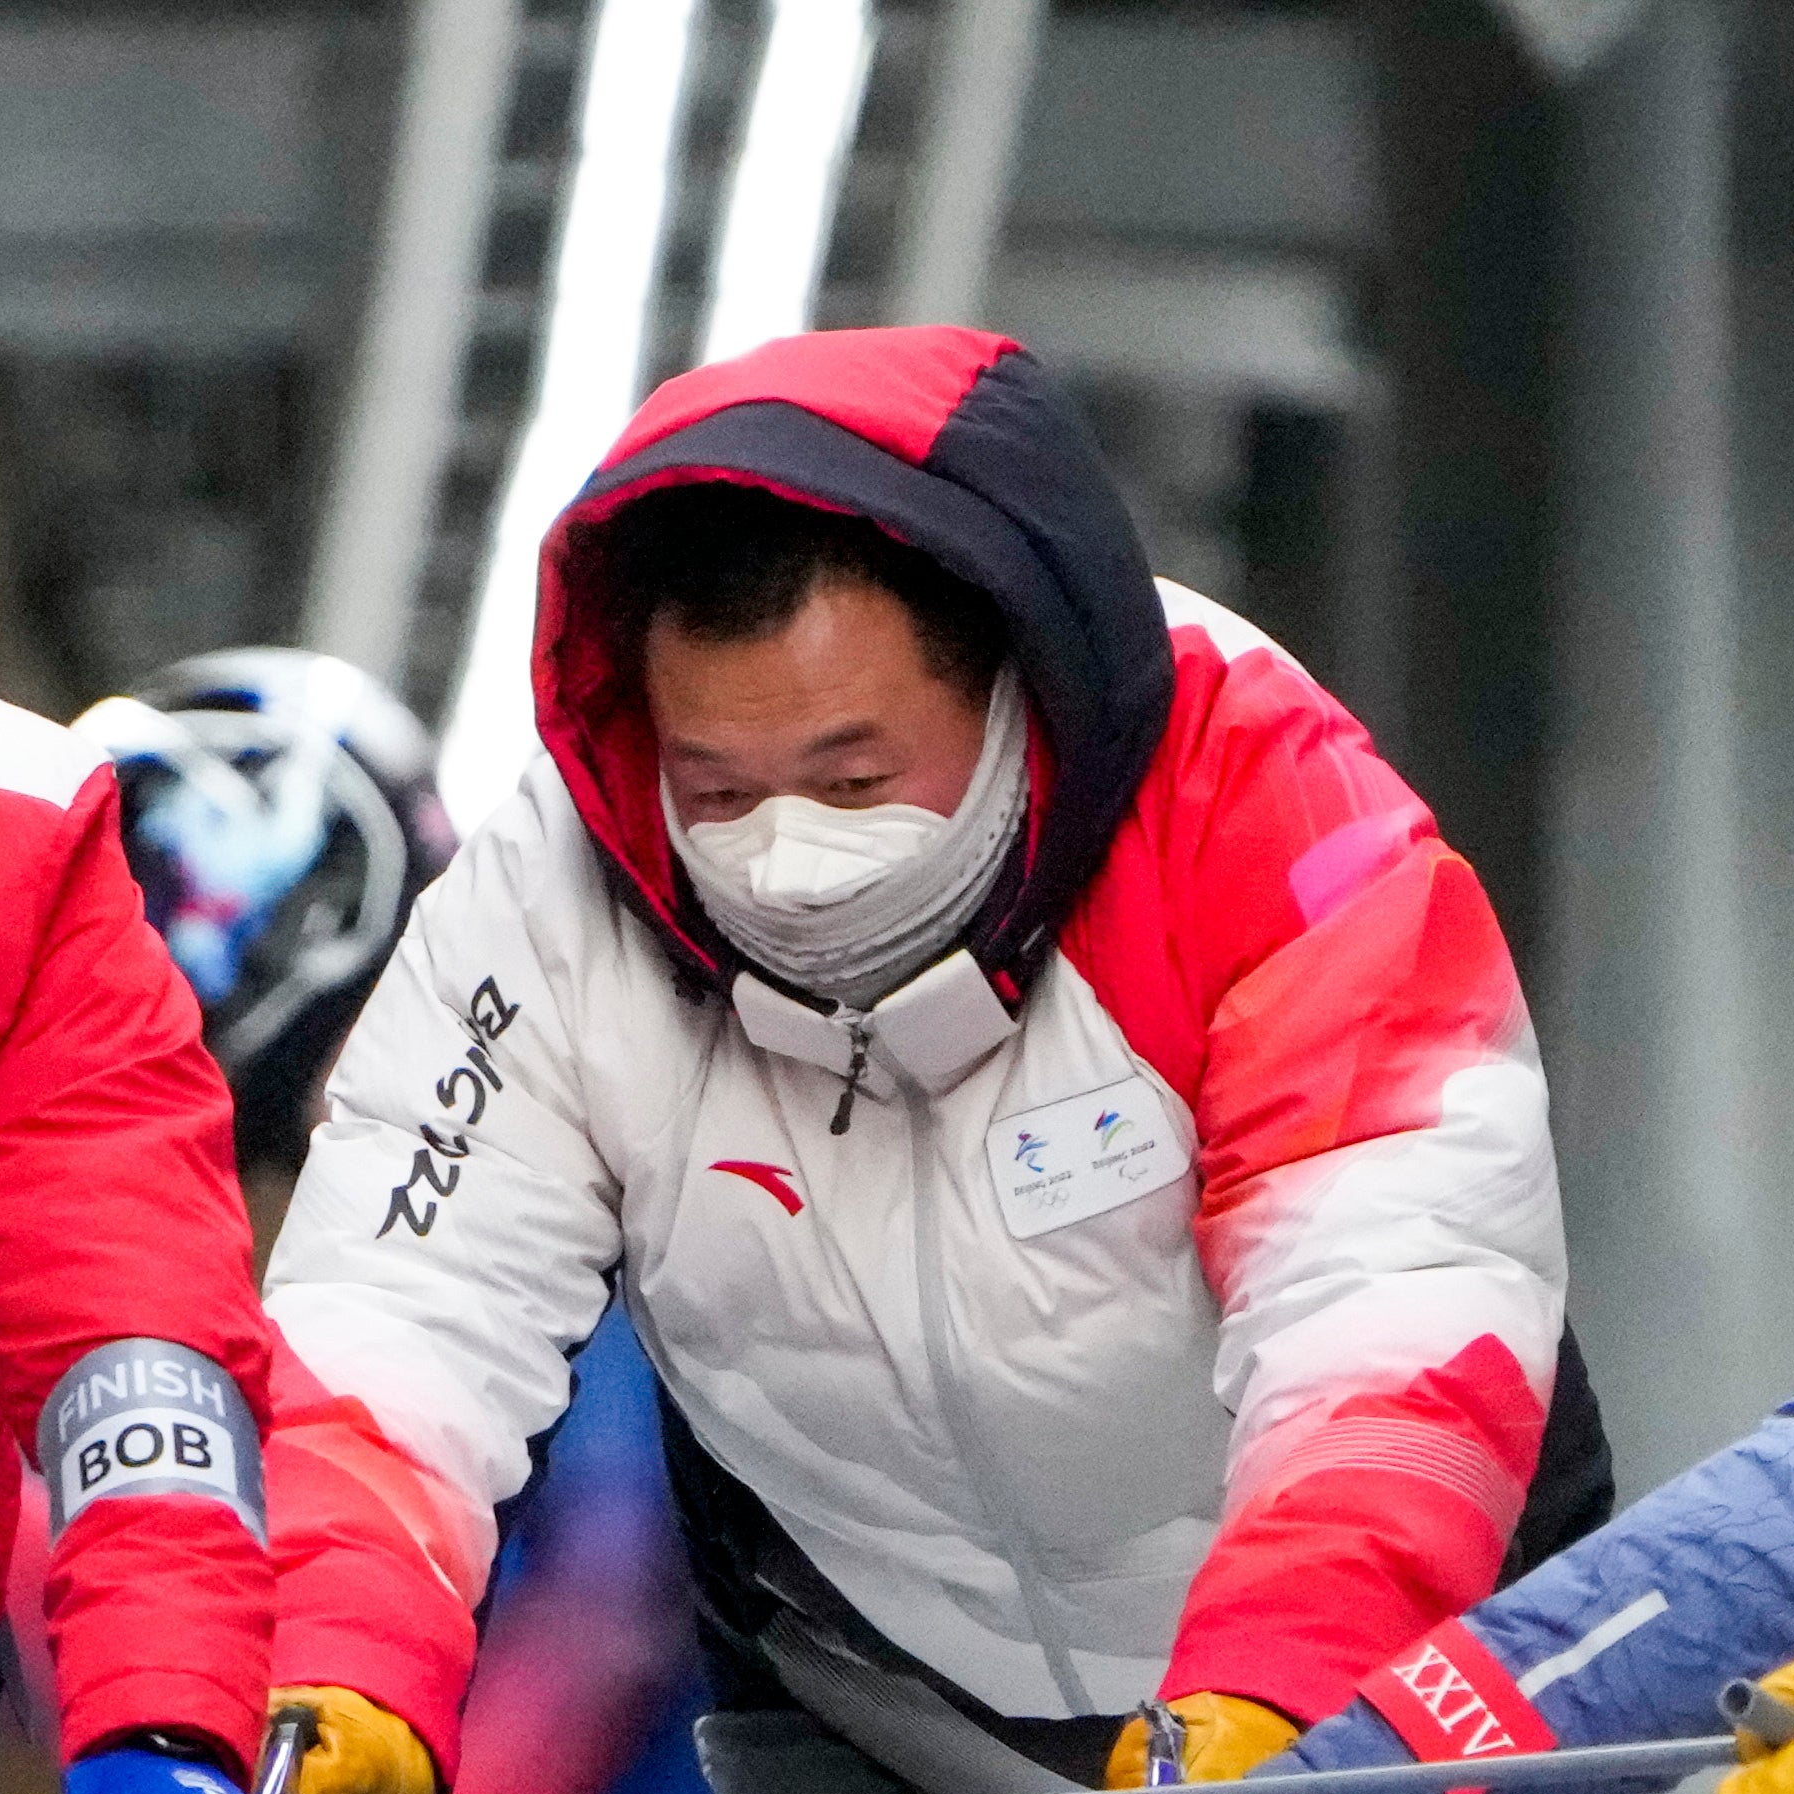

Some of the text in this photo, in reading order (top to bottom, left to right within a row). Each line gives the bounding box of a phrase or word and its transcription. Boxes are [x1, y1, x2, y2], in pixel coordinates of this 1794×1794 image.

[58, 1359, 227, 1443] FINISH
[79, 1422, 212, 1492] BOB
[1391, 1643, 1516, 1756] XXIV
